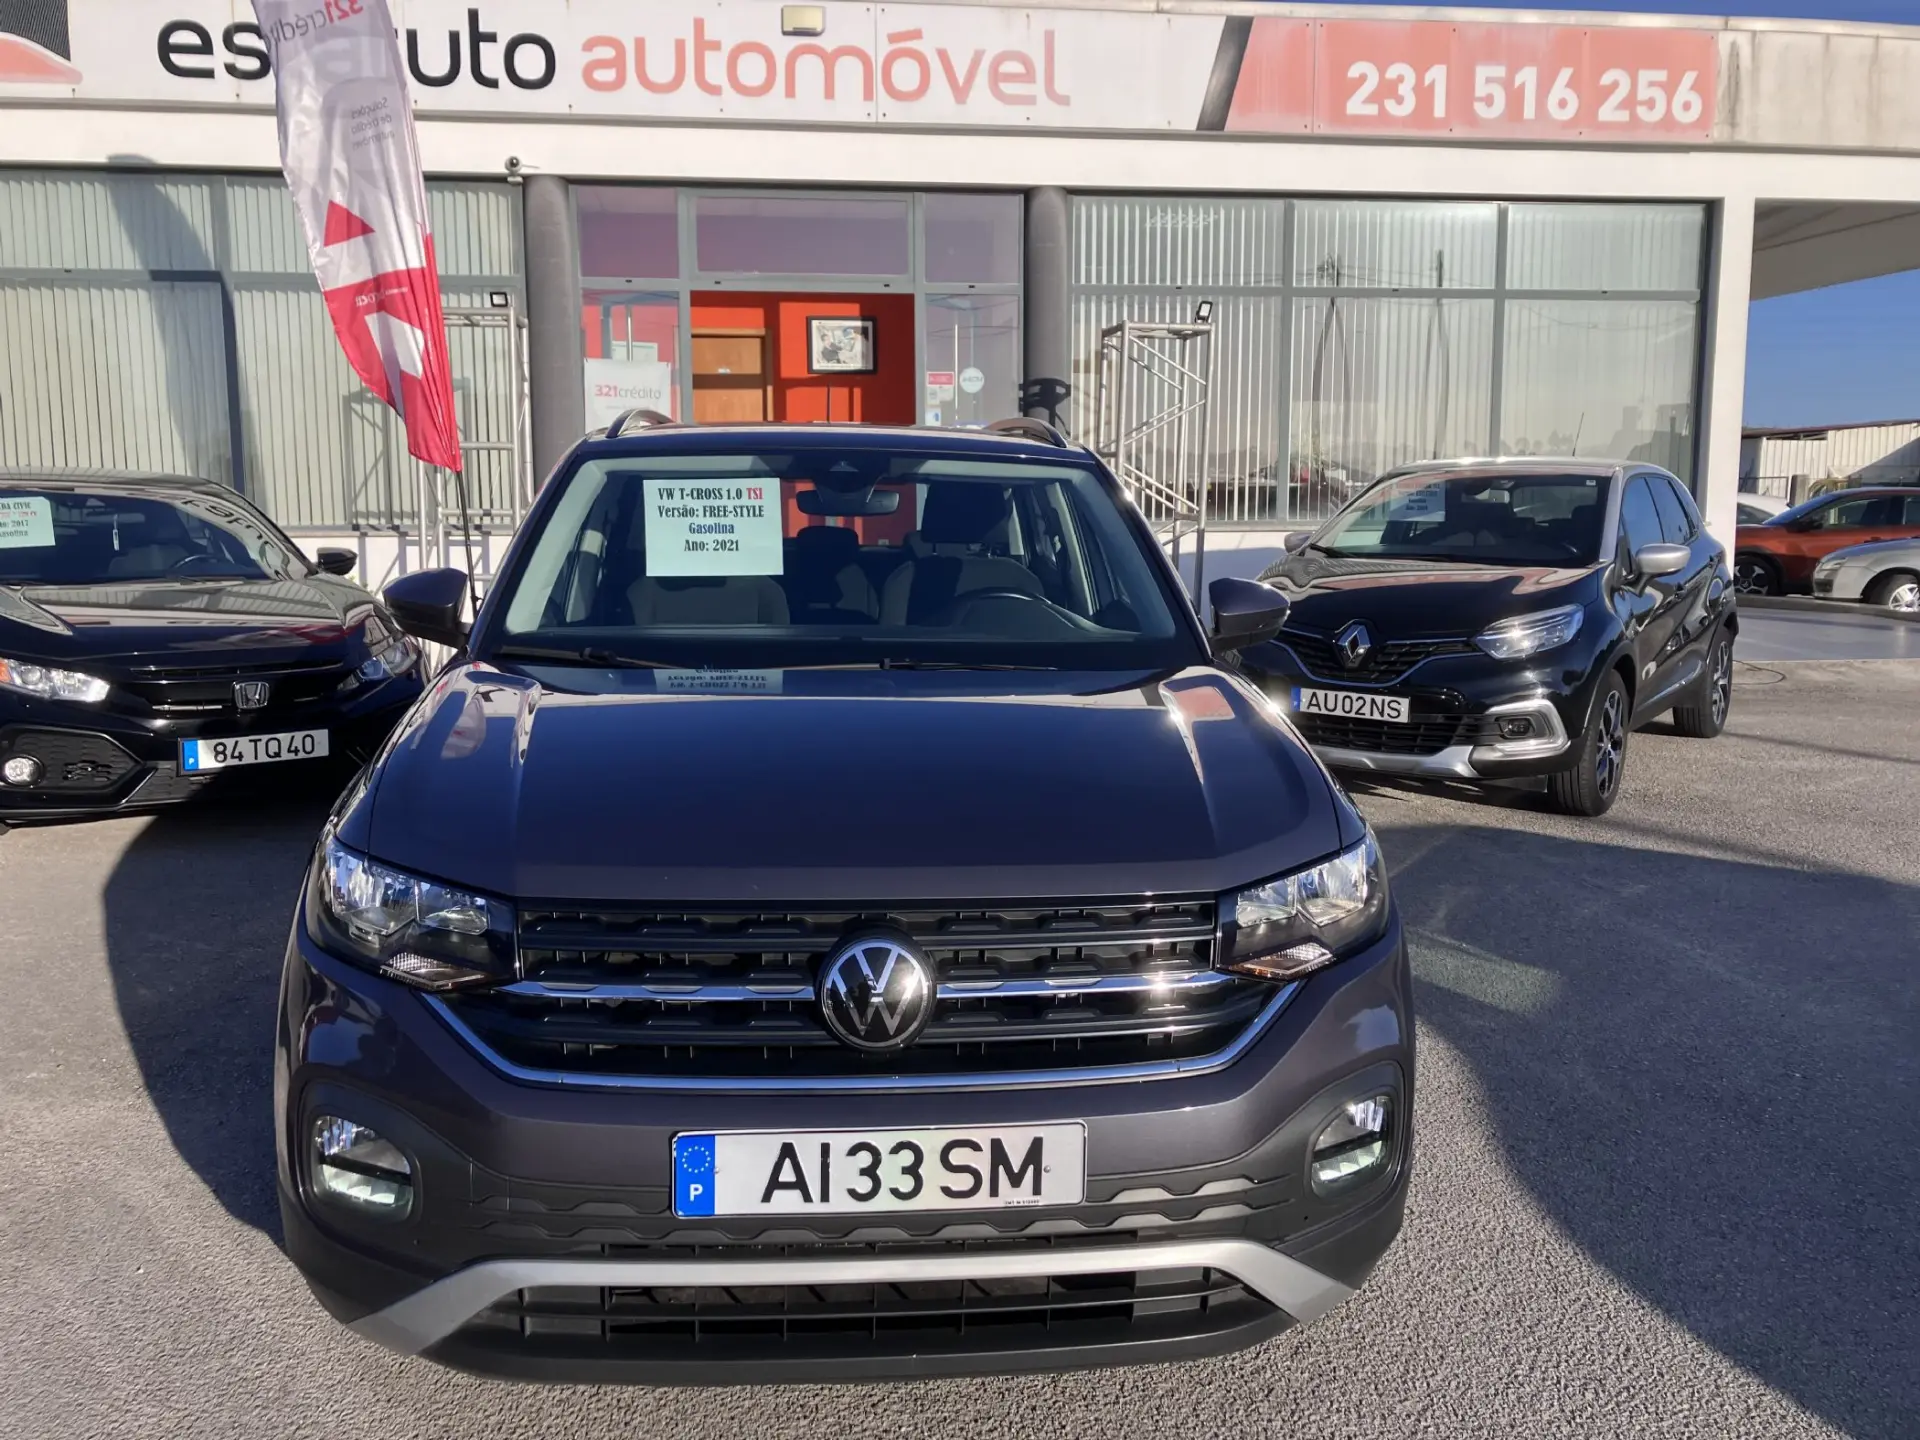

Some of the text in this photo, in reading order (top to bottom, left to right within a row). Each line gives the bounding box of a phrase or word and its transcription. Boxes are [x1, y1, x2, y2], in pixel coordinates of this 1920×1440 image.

[581, 17, 1071, 107] automóvel
[1346, 61, 1704, 125] 231 516 256
[594, 384, 662, 400] 321crédito
[657, 487, 763, 500] VW T-CROSS 1.0 TSI
[657, 504, 765, 518] Versão: FREE-STYLE
[688, 522, 735, 534] Gasolina
[683, 539, 739, 552] Ano: 2021
[1306, 691, 1402, 719] AU02NS
[689, 1184, 703, 1202] P
